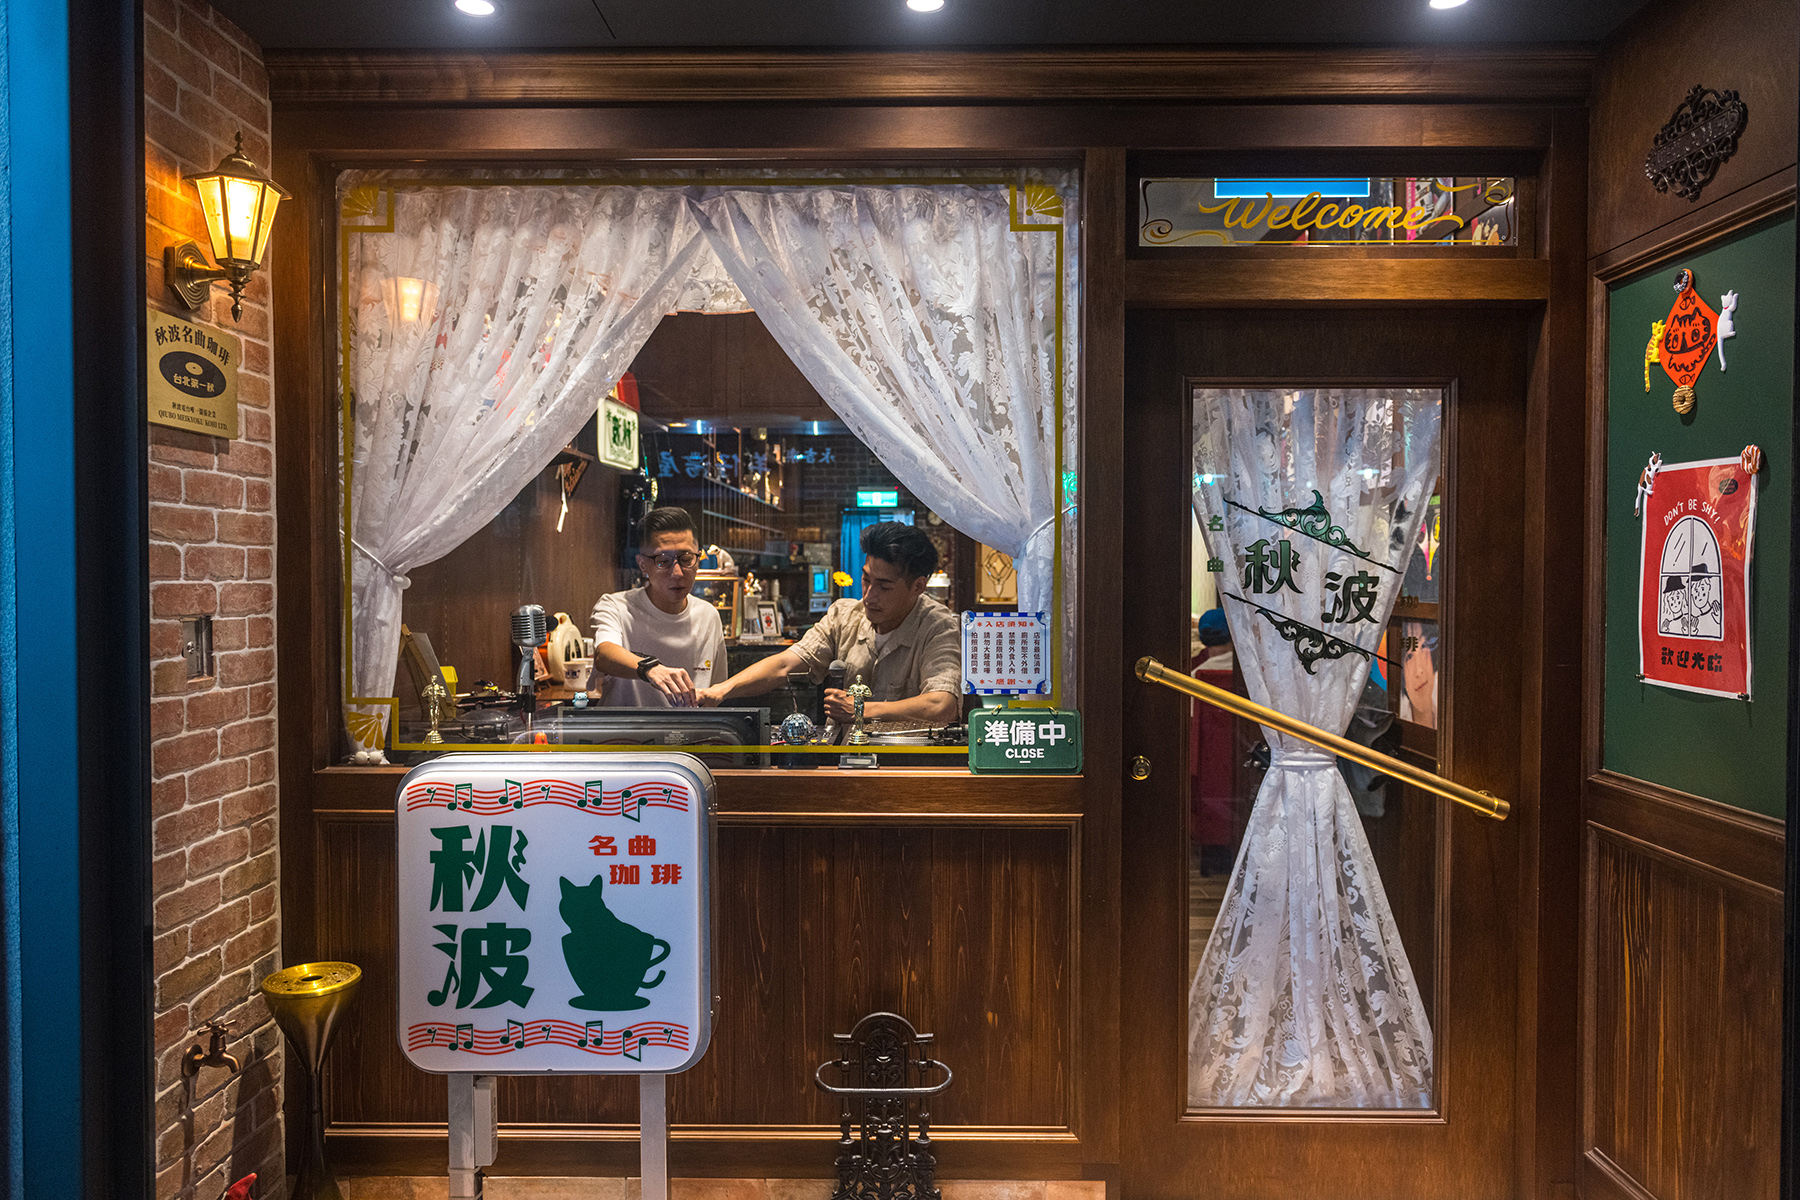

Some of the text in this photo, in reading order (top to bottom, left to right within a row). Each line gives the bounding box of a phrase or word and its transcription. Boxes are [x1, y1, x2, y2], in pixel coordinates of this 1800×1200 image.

[1198, 191, 1464, 230] Welcome
[154, 324, 230, 366] 秋波名曲珈琲
[1663, 498, 1721, 526] DON'T BE SHY!
[1207, 514, 1225, 573] 名曲
[1243, 539, 1380, 624] 秋波
[985, 620, 1028, 628] 入店須知
[1661, 646, 1723, 673] 歡迎光臨
[984, 720, 1066, 747] 準備中
[1005, 748, 1045, 759] CLOSE
[588, 835, 656, 856] 名曲
[609, 863, 683, 885] 珈琲
[427, 825, 535, 1009] 秋波
